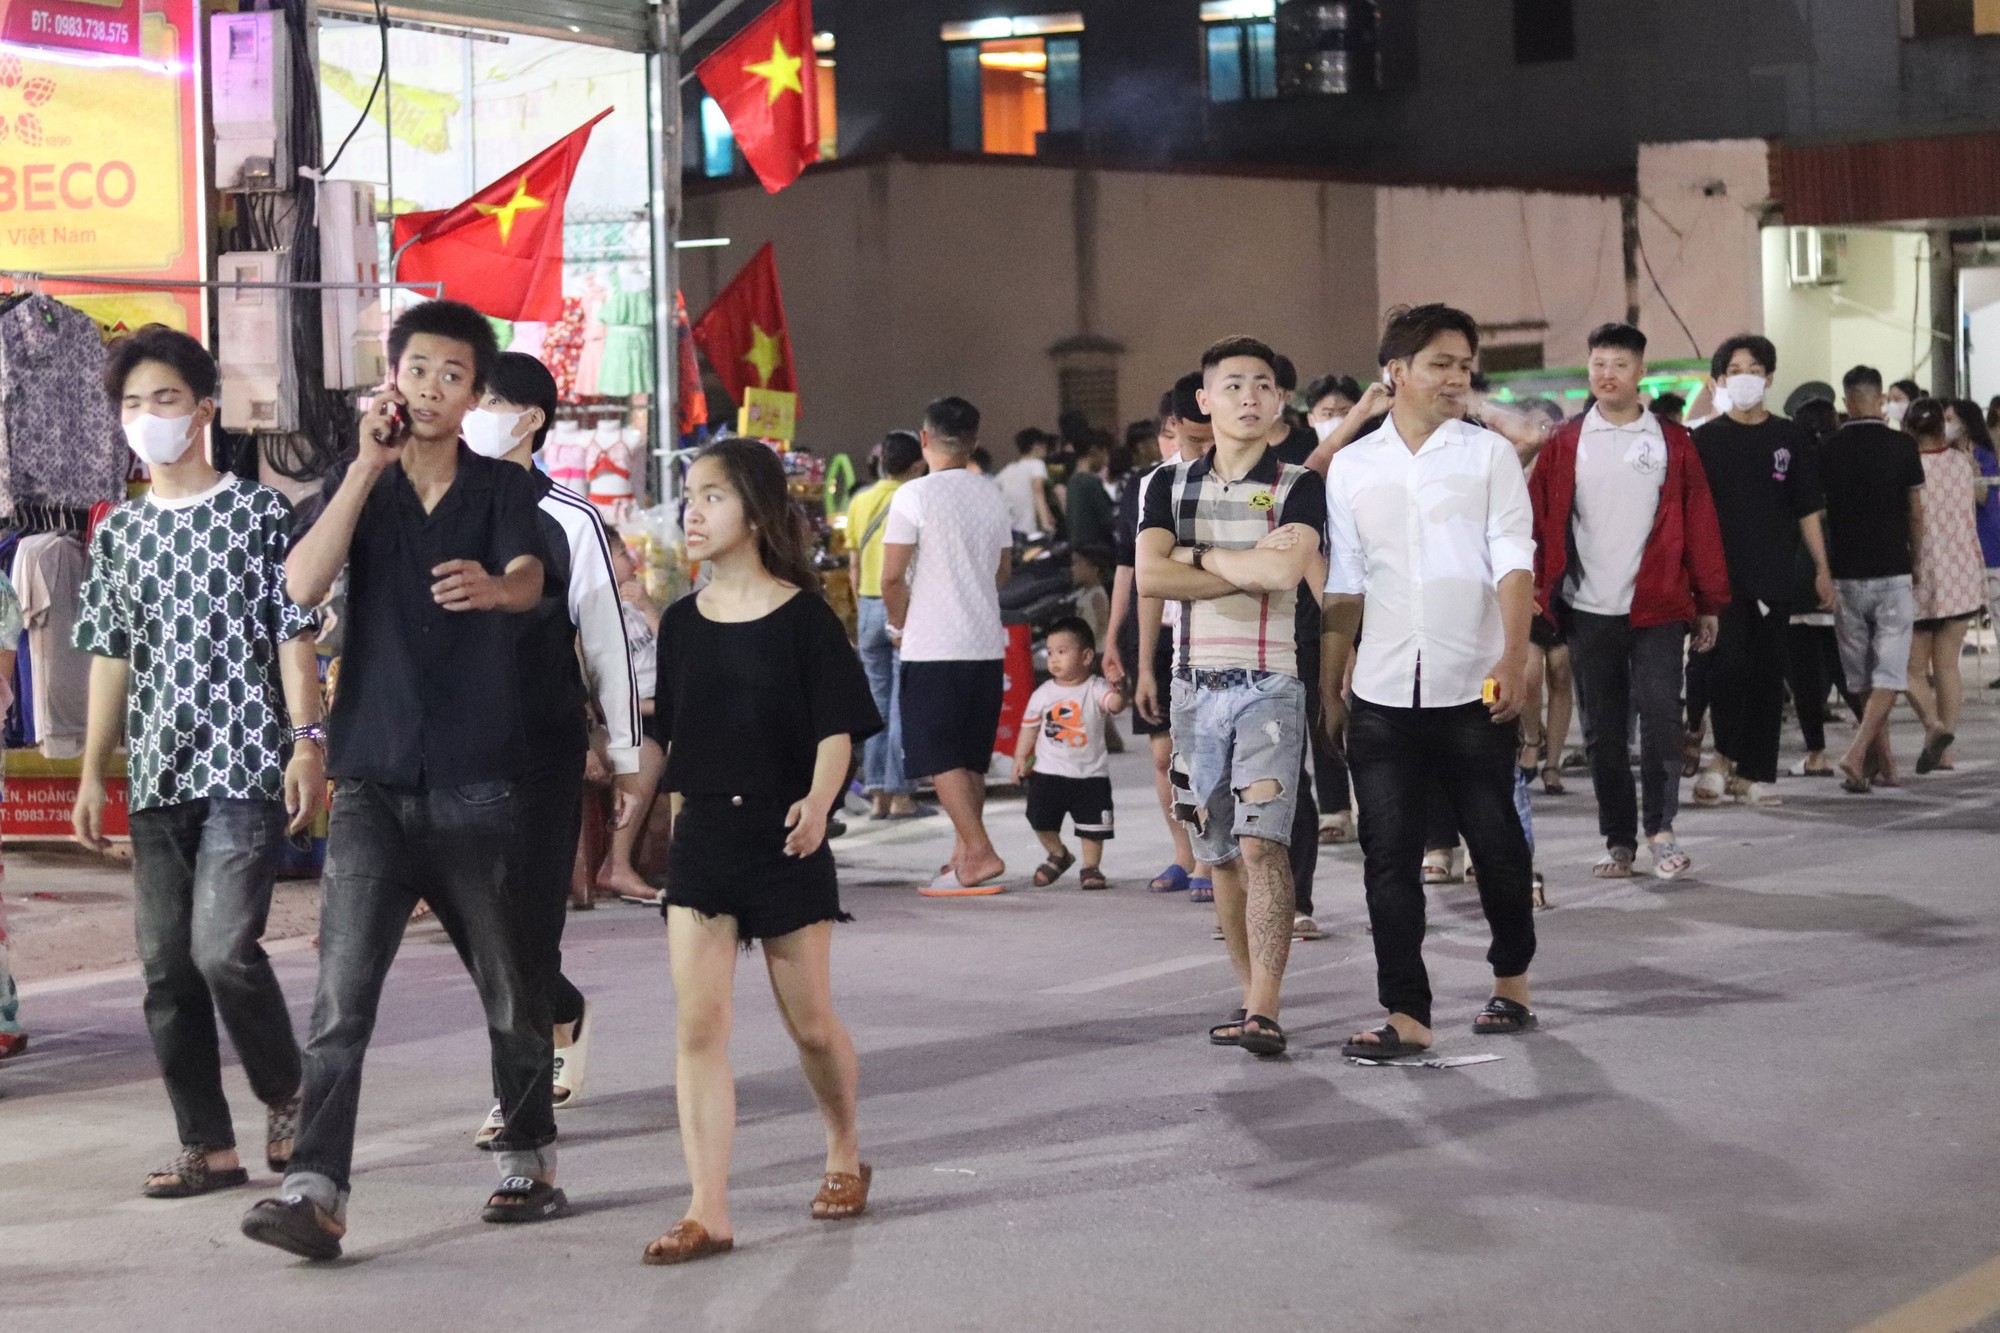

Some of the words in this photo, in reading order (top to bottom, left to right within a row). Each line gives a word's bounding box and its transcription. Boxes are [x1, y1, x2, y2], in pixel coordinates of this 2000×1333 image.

[31, 10, 52, 34] ĐT:
[54, 14, 129, 44] 0983.738.575
[7, 227, 46, 249] Việt
[53, 226, 97, 244] Nam
[828, 1181, 842, 1190] VIP
